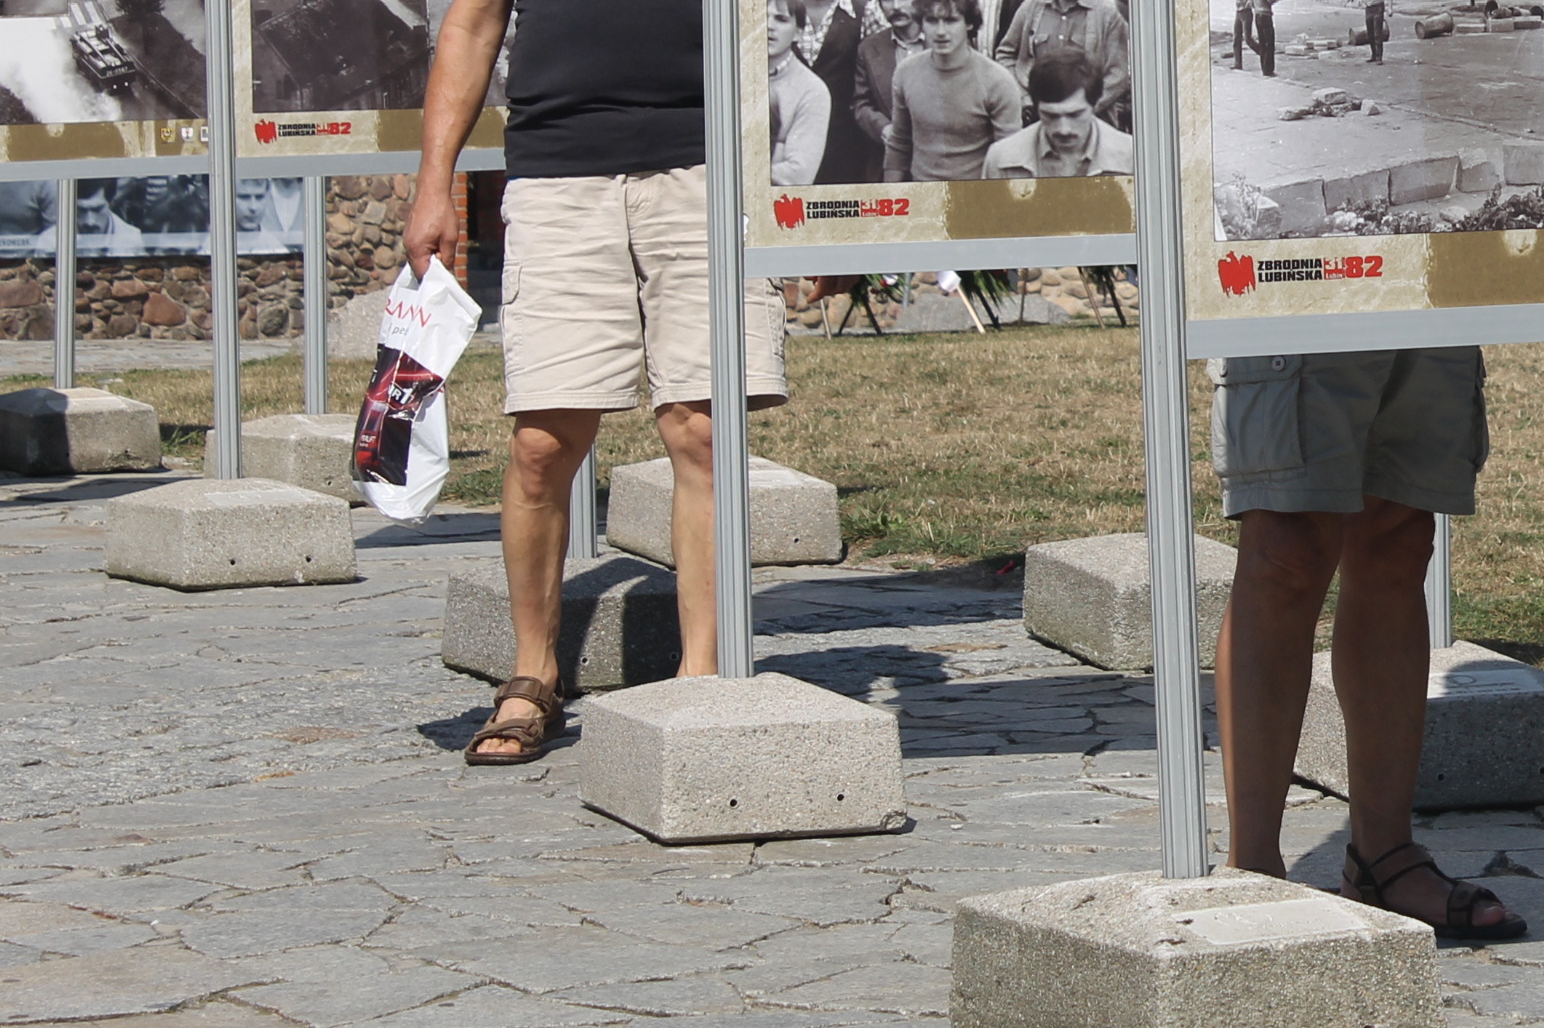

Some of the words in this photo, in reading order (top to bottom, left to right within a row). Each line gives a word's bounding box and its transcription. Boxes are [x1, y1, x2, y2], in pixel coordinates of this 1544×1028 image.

[328, 122, 352, 135] 82
[806, 200, 860, 210] ZBRODNIA
[878, 198, 909, 216] 82
[1257, 258, 1322, 271] ZBRODNIA
[1345, 256, 1383, 278] 82
